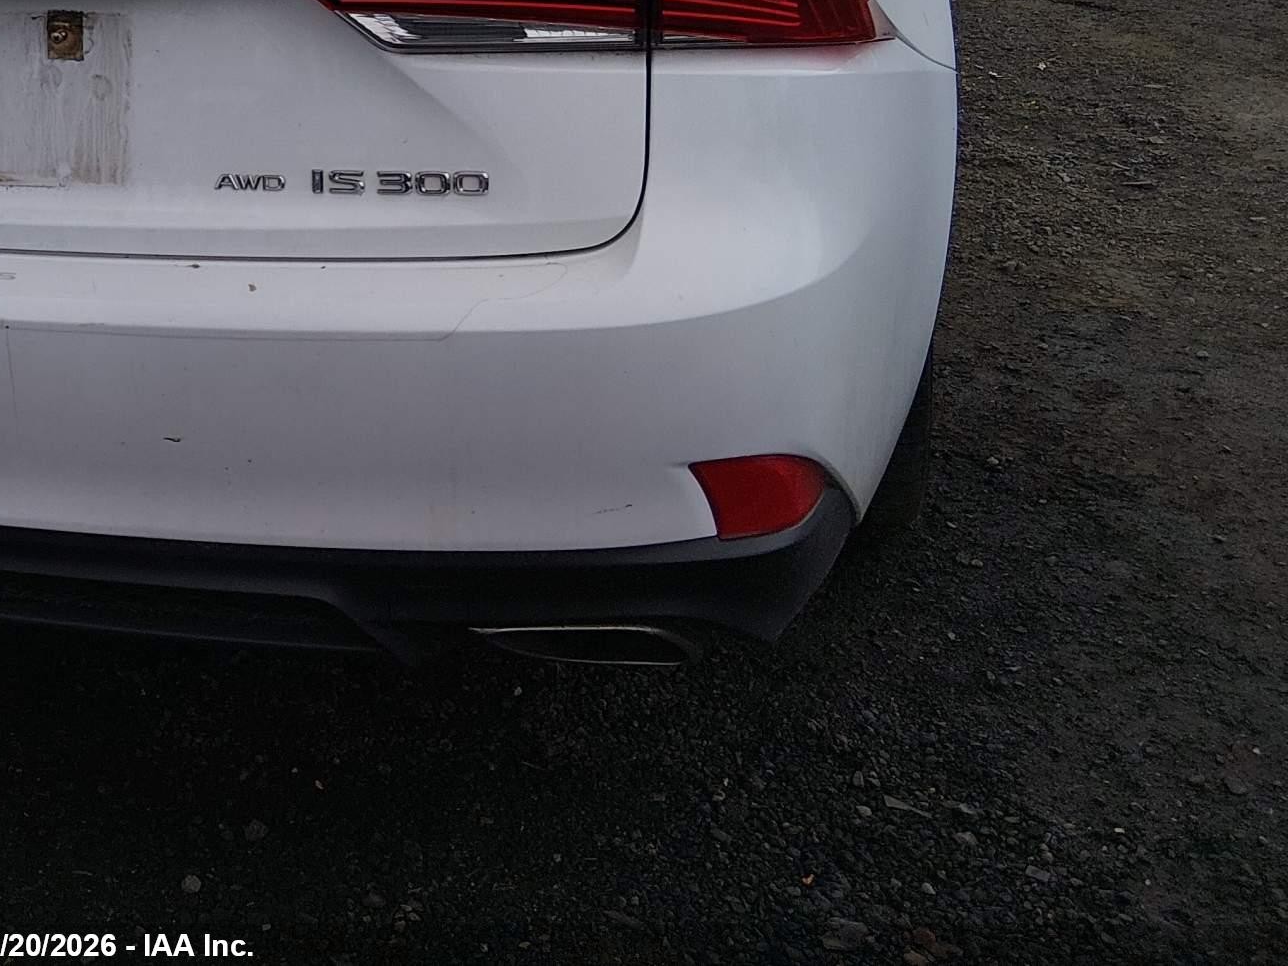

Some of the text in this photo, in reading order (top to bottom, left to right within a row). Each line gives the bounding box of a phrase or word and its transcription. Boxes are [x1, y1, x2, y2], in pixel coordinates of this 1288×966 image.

[214, 169, 490, 196] AWD IS 300
